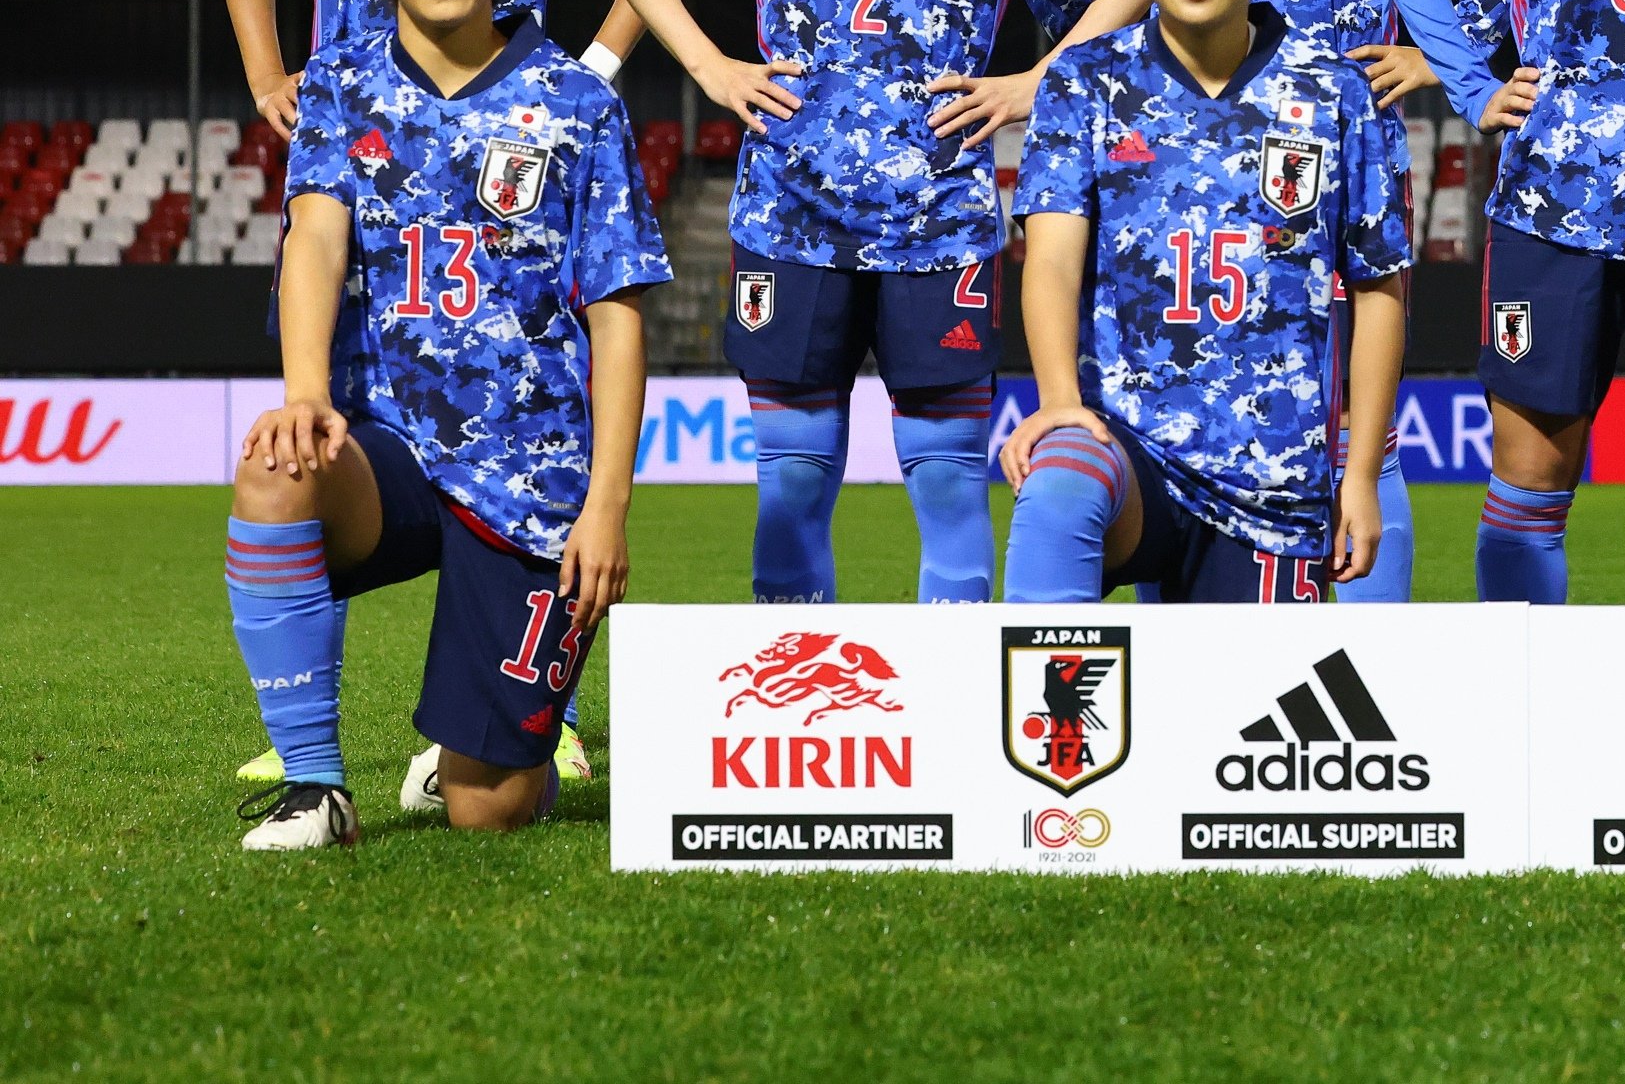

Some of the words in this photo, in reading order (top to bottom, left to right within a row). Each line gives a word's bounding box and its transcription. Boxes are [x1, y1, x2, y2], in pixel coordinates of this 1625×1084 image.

[503, 143, 535, 155] JAPAN
[1278, 140, 1310, 151] JAPAN
[395, 223, 480, 321] 13
[1163, 228, 1248, 324] 15
[939, 337, 982, 350] adidas
[1031, 629, 1101, 645] JAPAN
[711, 736, 912, 788] KIRIN
[1036, 742, 1096, 767] JFA
[1215, 742, 1431, 792] adidas
[681, 824, 809, 851] OFFICIAL
[814, 823, 944, 850] PARTNER
[1189, 823, 1318, 849] OFFICIAL
[1322, 822, 1457, 849] SUPPLIER
[1038, 852, 1096, 863] 1921-2021
